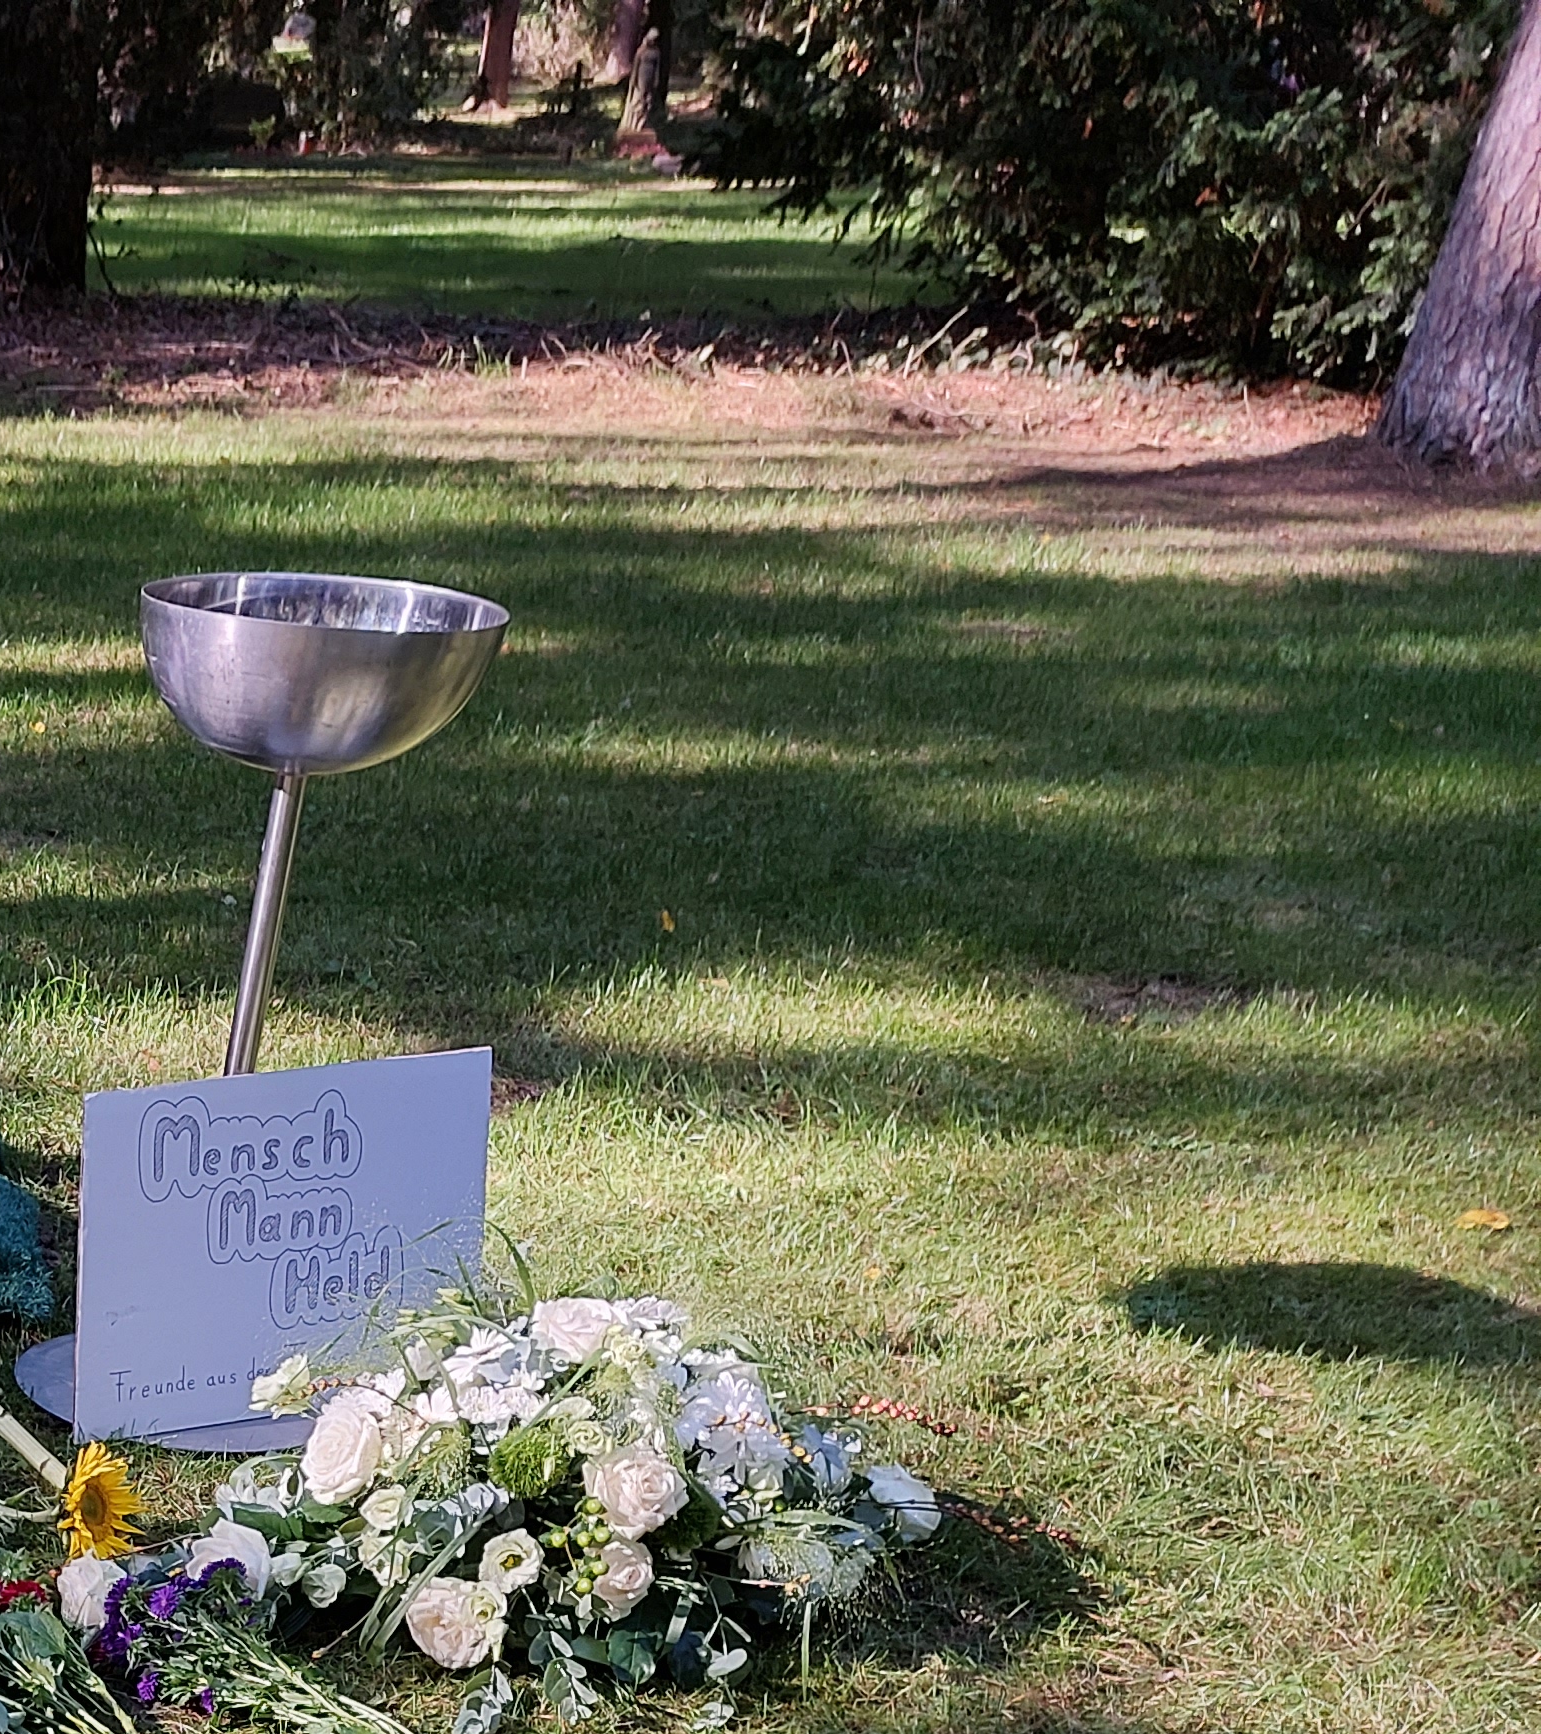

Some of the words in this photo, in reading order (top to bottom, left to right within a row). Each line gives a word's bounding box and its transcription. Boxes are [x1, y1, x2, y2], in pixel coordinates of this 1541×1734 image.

[153, 1107, 350, 1182] Mensch
[219, 1188, 342, 1250] Mann
[285, 1245, 391, 1314] Held
[109, 1365, 196, 1402] Freunde
[206, 1371, 237, 1387] aus
